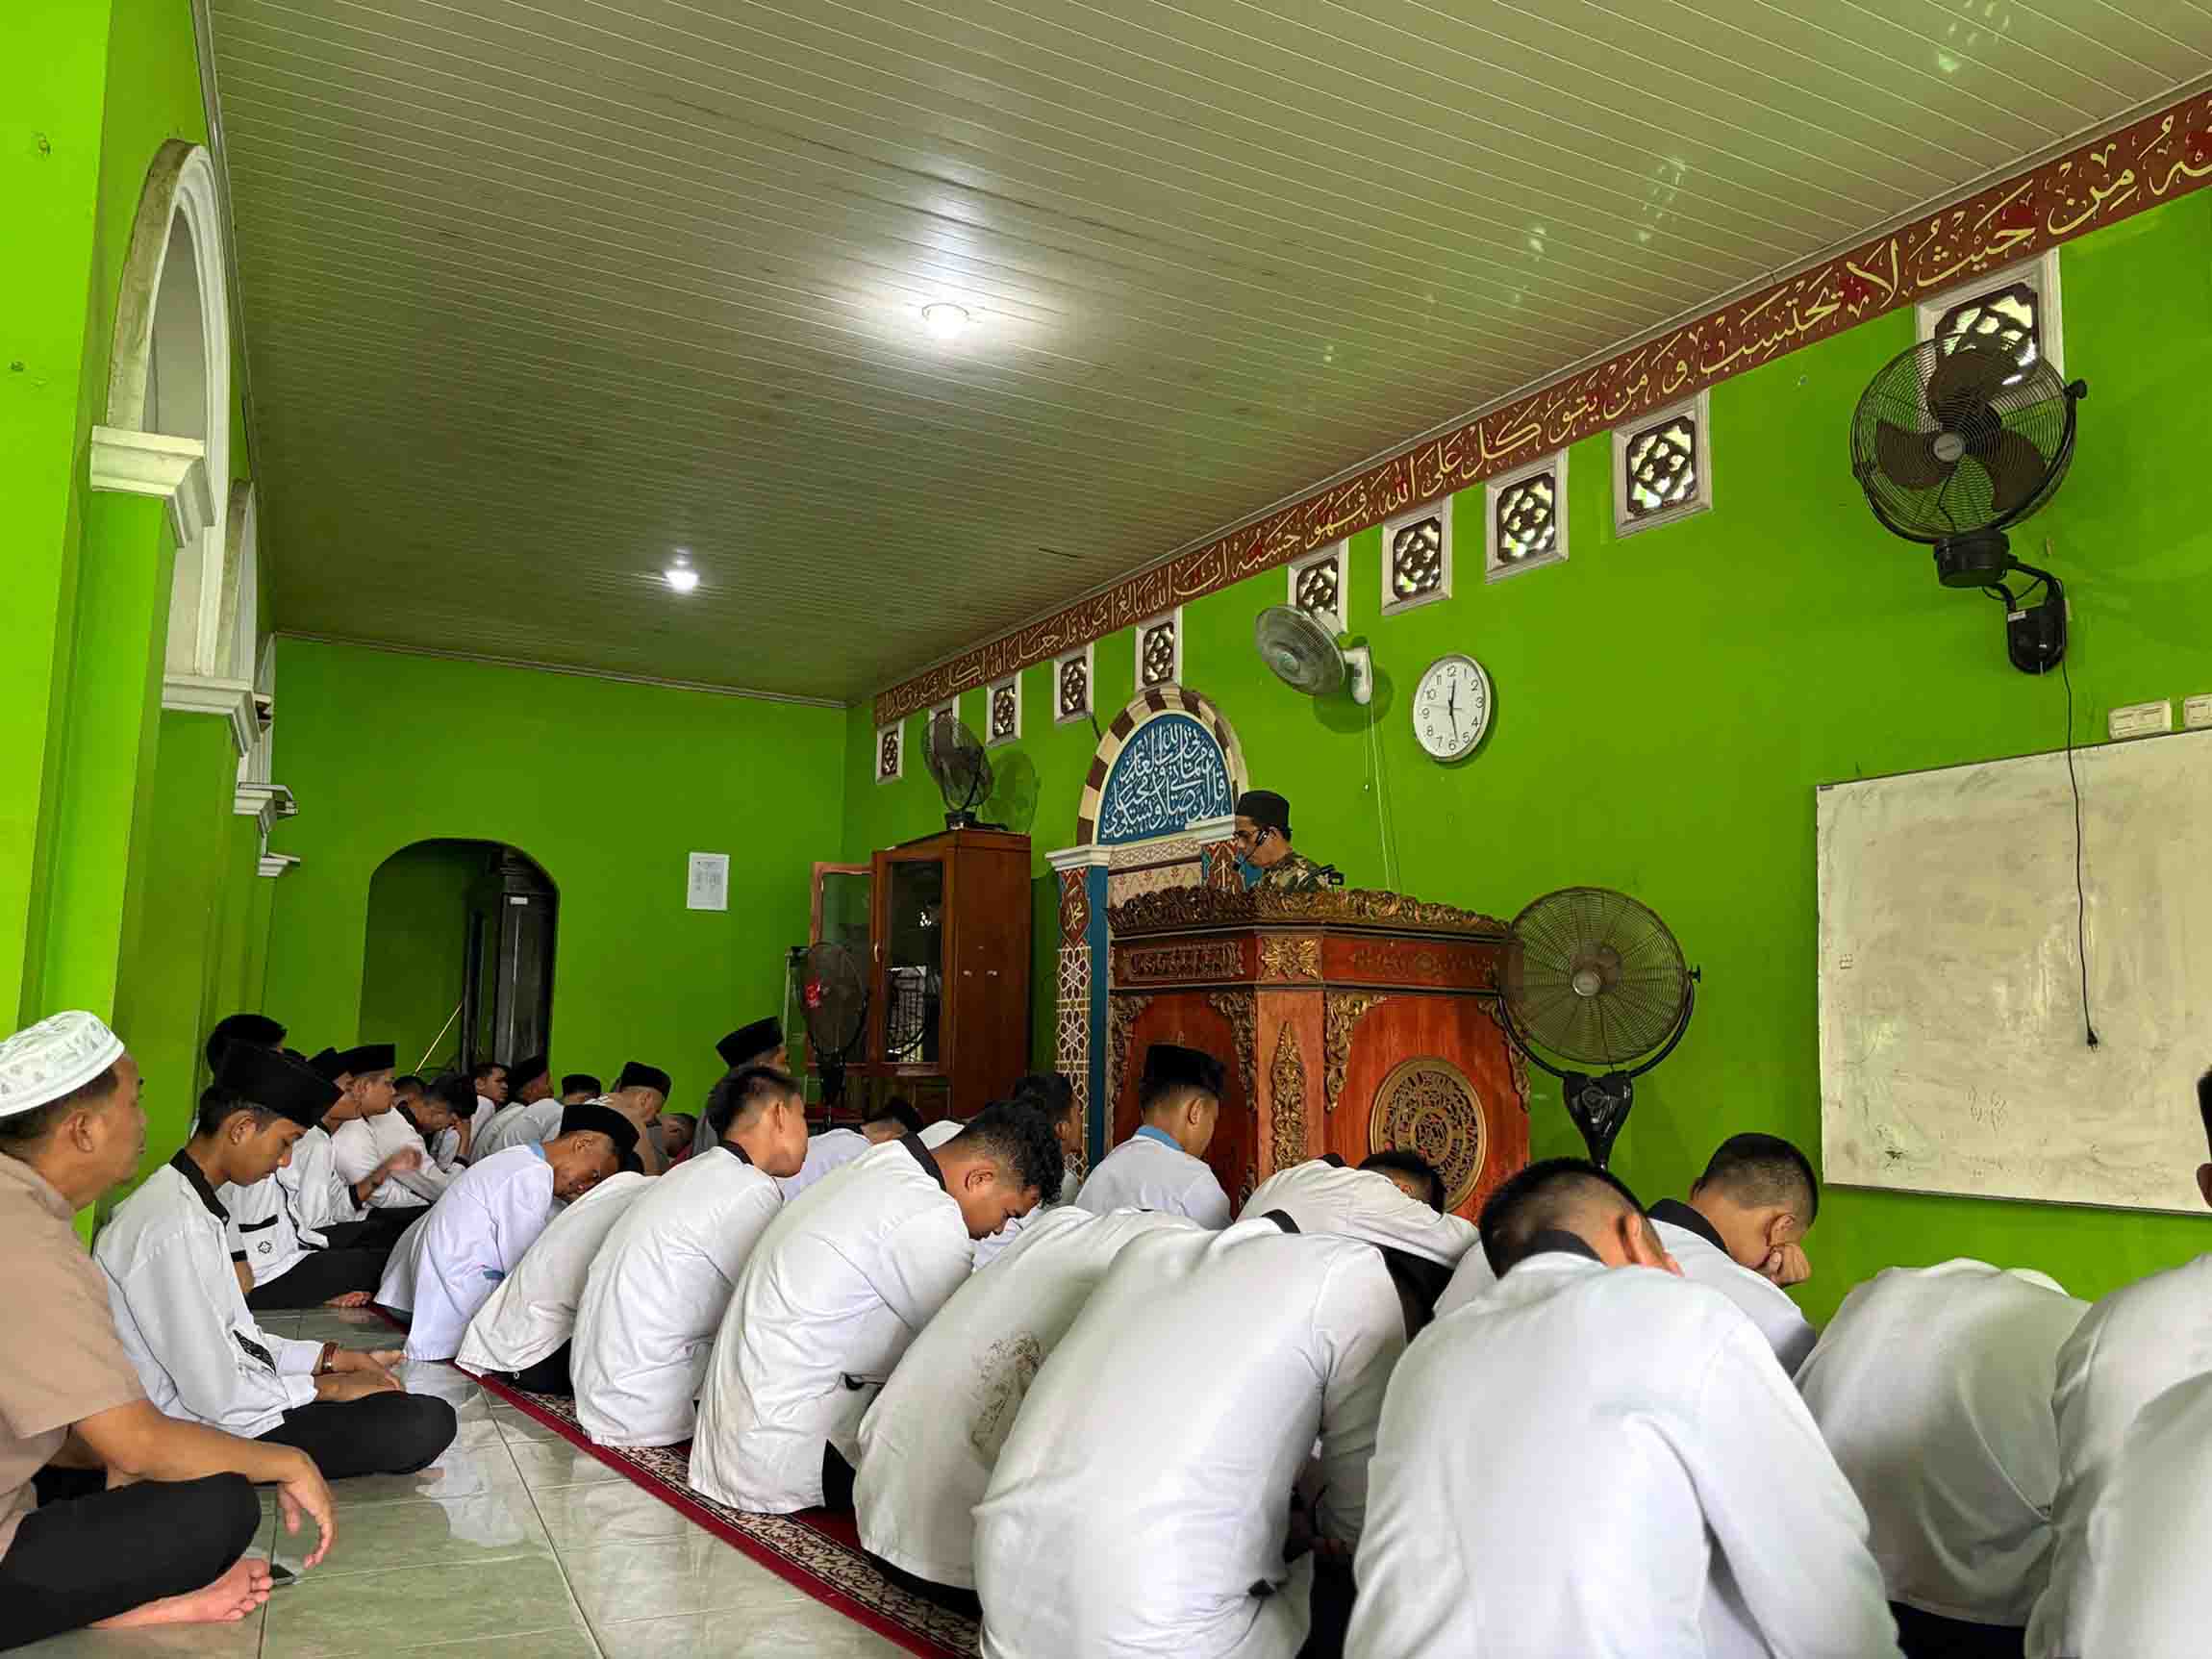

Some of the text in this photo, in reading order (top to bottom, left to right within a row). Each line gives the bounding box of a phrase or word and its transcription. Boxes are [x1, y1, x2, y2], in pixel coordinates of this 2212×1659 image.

[2047, 159, 2137, 236] من
[1914, 204, 2036, 287] حيث
[1847, 238, 1899, 310] لا
[1421, 438, 1463, 497] على
[1378, 455, 1416, 515] الله
[1305, 484, 1367, 550] فهو
[1471, 680, 1479, 691] 2
[1476, 697, 1484, 709] 3
[1422, 708, 1430, 719] 9
[1471, 716, 1481, 728] 4
[1426, 725, 1434, 737] 8
[1436, 736, 1444, 747] 7
[1463, 732, 1470, 743] 5
[1447, 739, 1456, 751] 6
